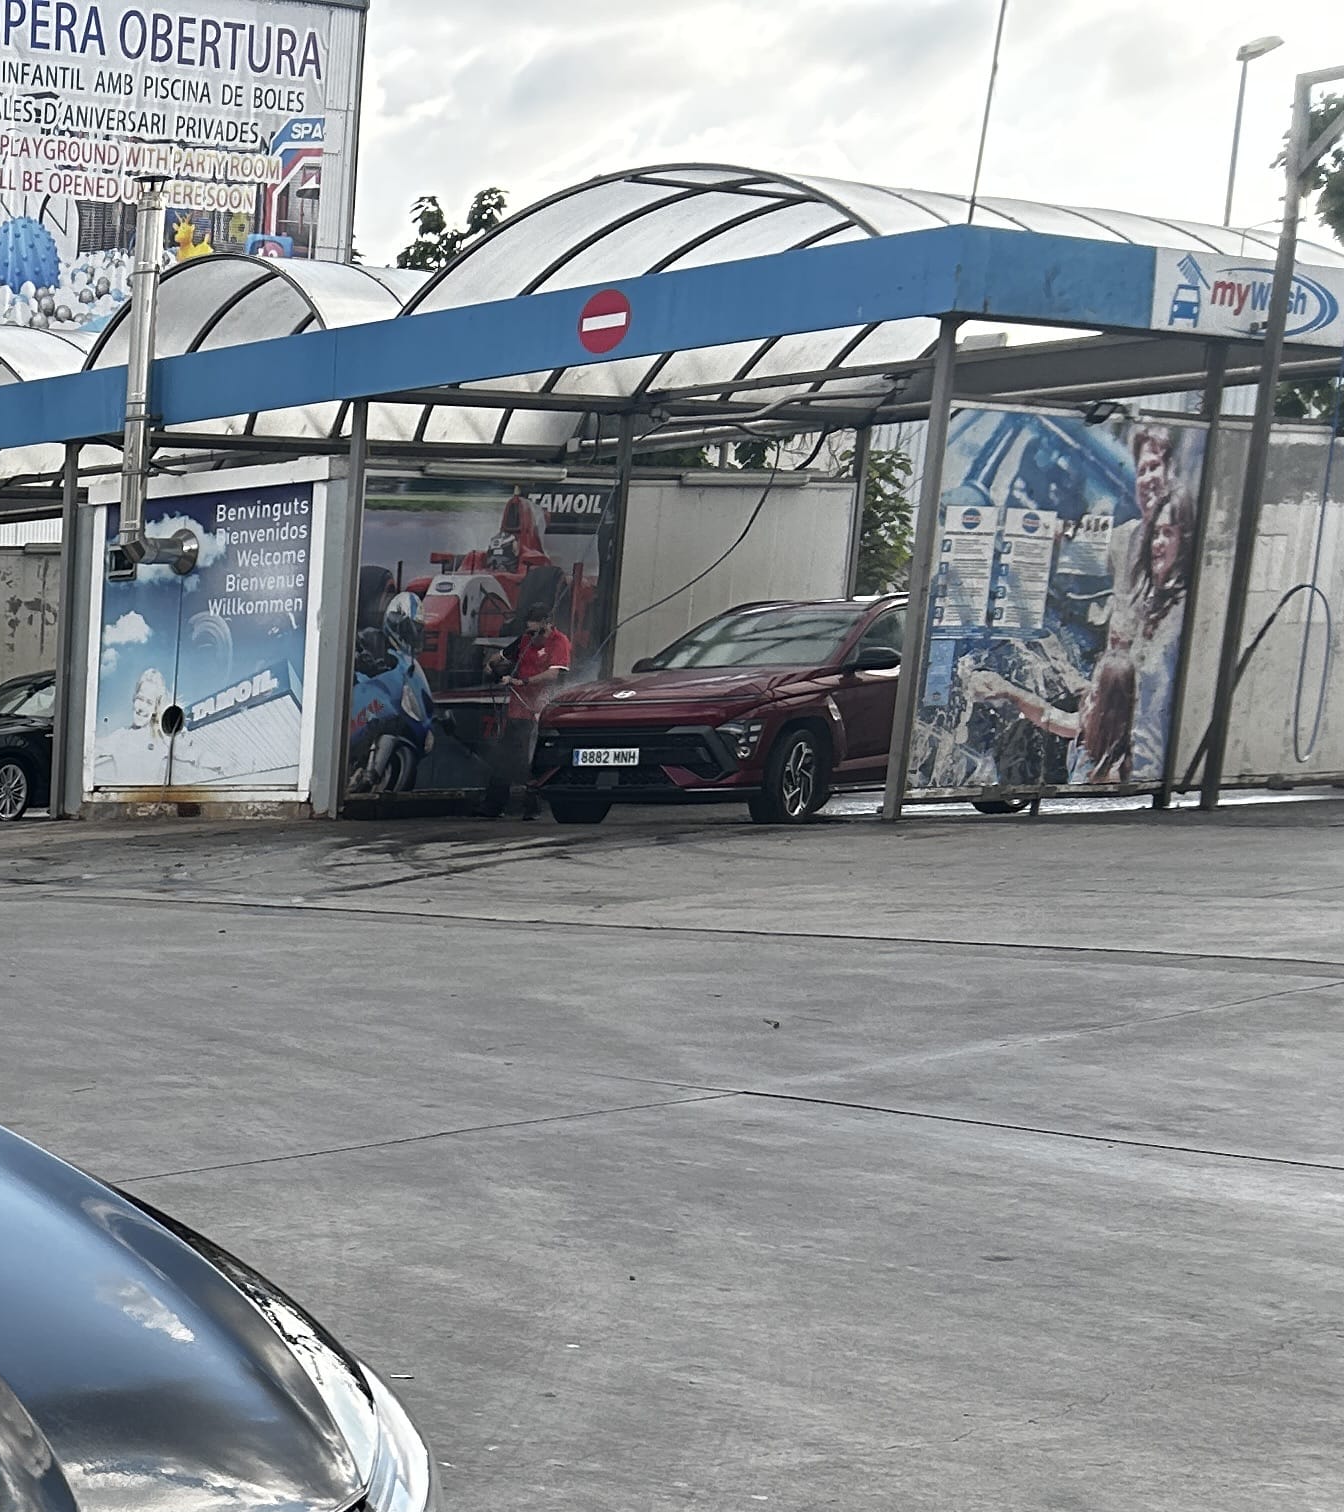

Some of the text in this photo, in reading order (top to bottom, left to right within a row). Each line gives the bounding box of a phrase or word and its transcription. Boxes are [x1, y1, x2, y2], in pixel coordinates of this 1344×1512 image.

[119, 9, 322, 81] OBERTURA
[2, 61, 85, 91] INFANTIL
[95, 71, 133, 95] AMB
[143, 76, 211, 104] PISCINA
[221, 84, 244, 107] DE
[253, 87, 305, 113] BOLES
[44, 102, 166, 136] D'ANIVERSARI
[175, 116, 259, 144] PRIVADES
[0, 136, 120, 166] PLAYGROUND
[126, 148, 168, 170] WITH
[173, 151, 223, 175] PARTY
[230, 157, 281, 181] ROOM
[23, 171, 44, 193] BE
[49, 173, 119, 198] OPENED
[205, 187, 253, 209] SOON
[1210, 280, 1307, 316] myWsh
[216, 498, 309, 522] Benvinguts
[528, 493, 602, 514] TAMOIL
[216, 522, 308, 545] Bienvenidos
[237, 548, 306, 567] Welcome
[226, 574, 305, 592] Bienvenue
[208, 597, 303, 617] Willkommen
[581, 750, 610, 764] 8882
